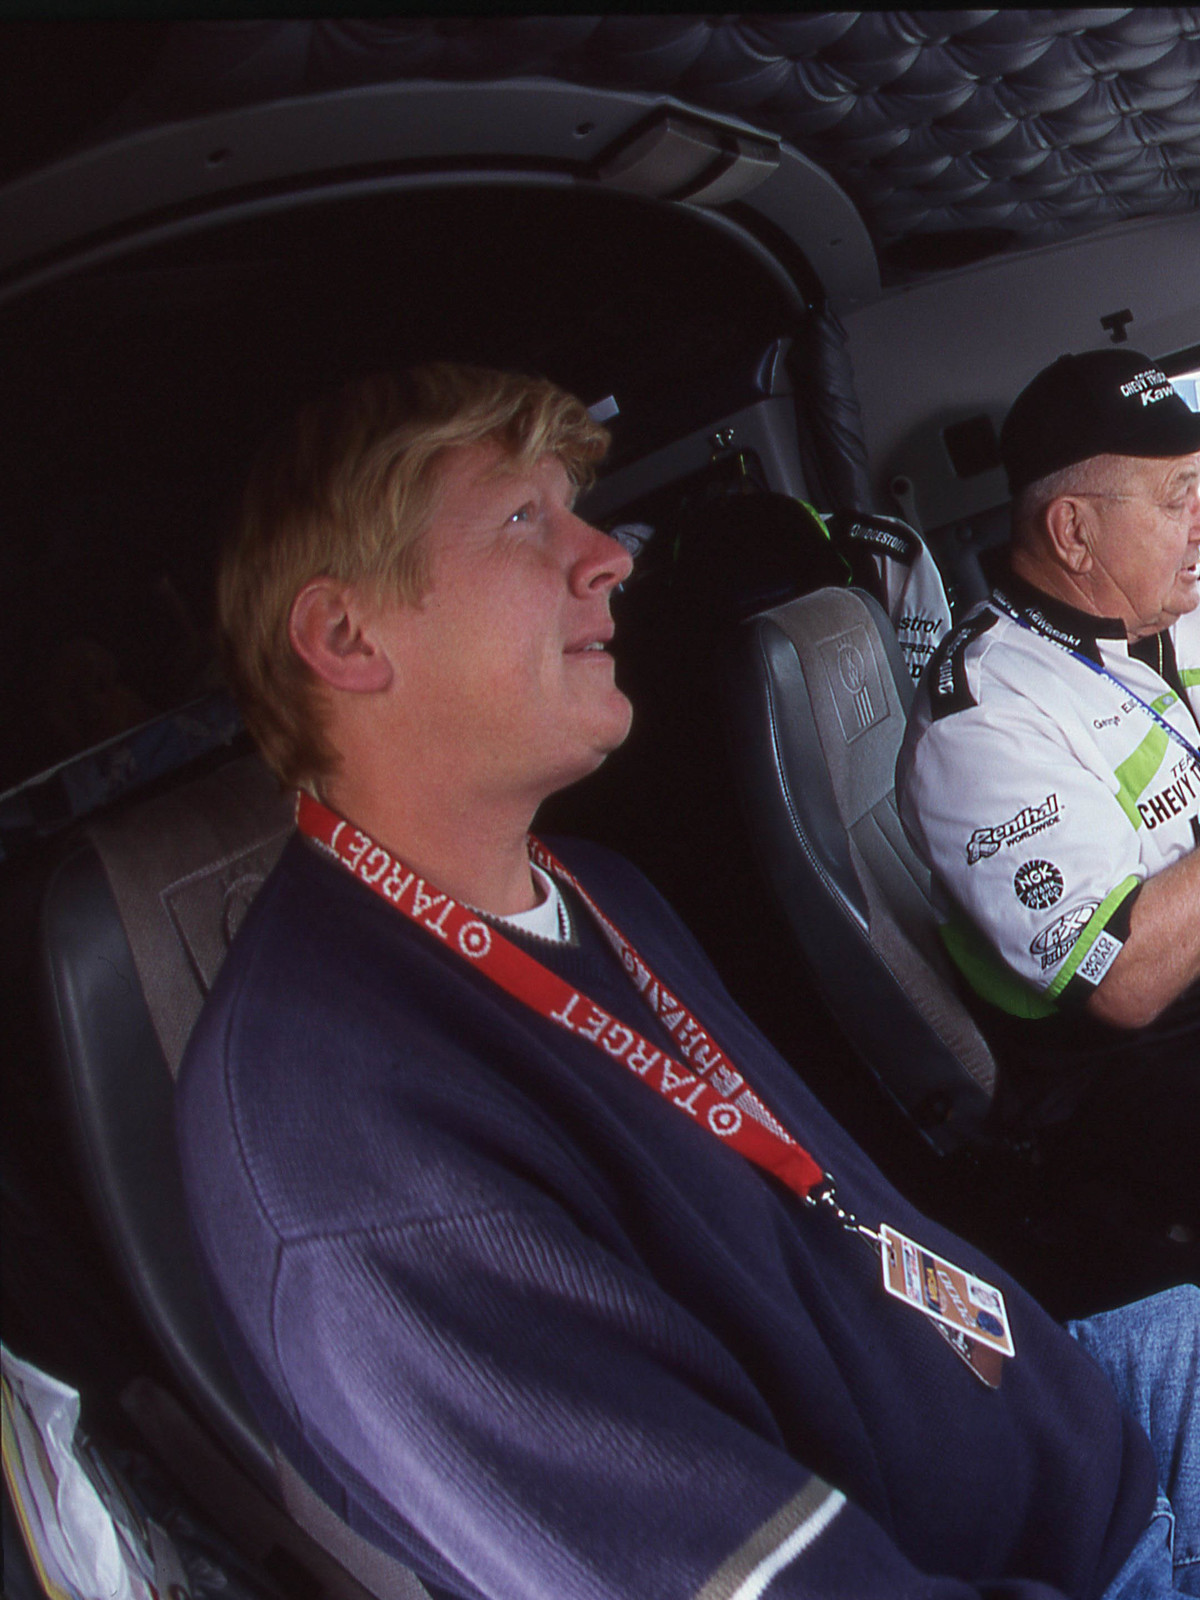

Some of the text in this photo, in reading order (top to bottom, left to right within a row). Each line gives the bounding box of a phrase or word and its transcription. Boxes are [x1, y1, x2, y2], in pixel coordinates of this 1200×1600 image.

[1120, 379, 1148, 397] CHEVY
[1137, 774, 1198, 831] CHEVY
[966, 793, 1060, 867] Renthal
[1006, 815, 1061, 848] WORLDWIDE
[1017, 862, 1053, 891] NGK
[1081, 937, 1108, 974] MOTO
[551, 994, 708, 1116] TARGET
